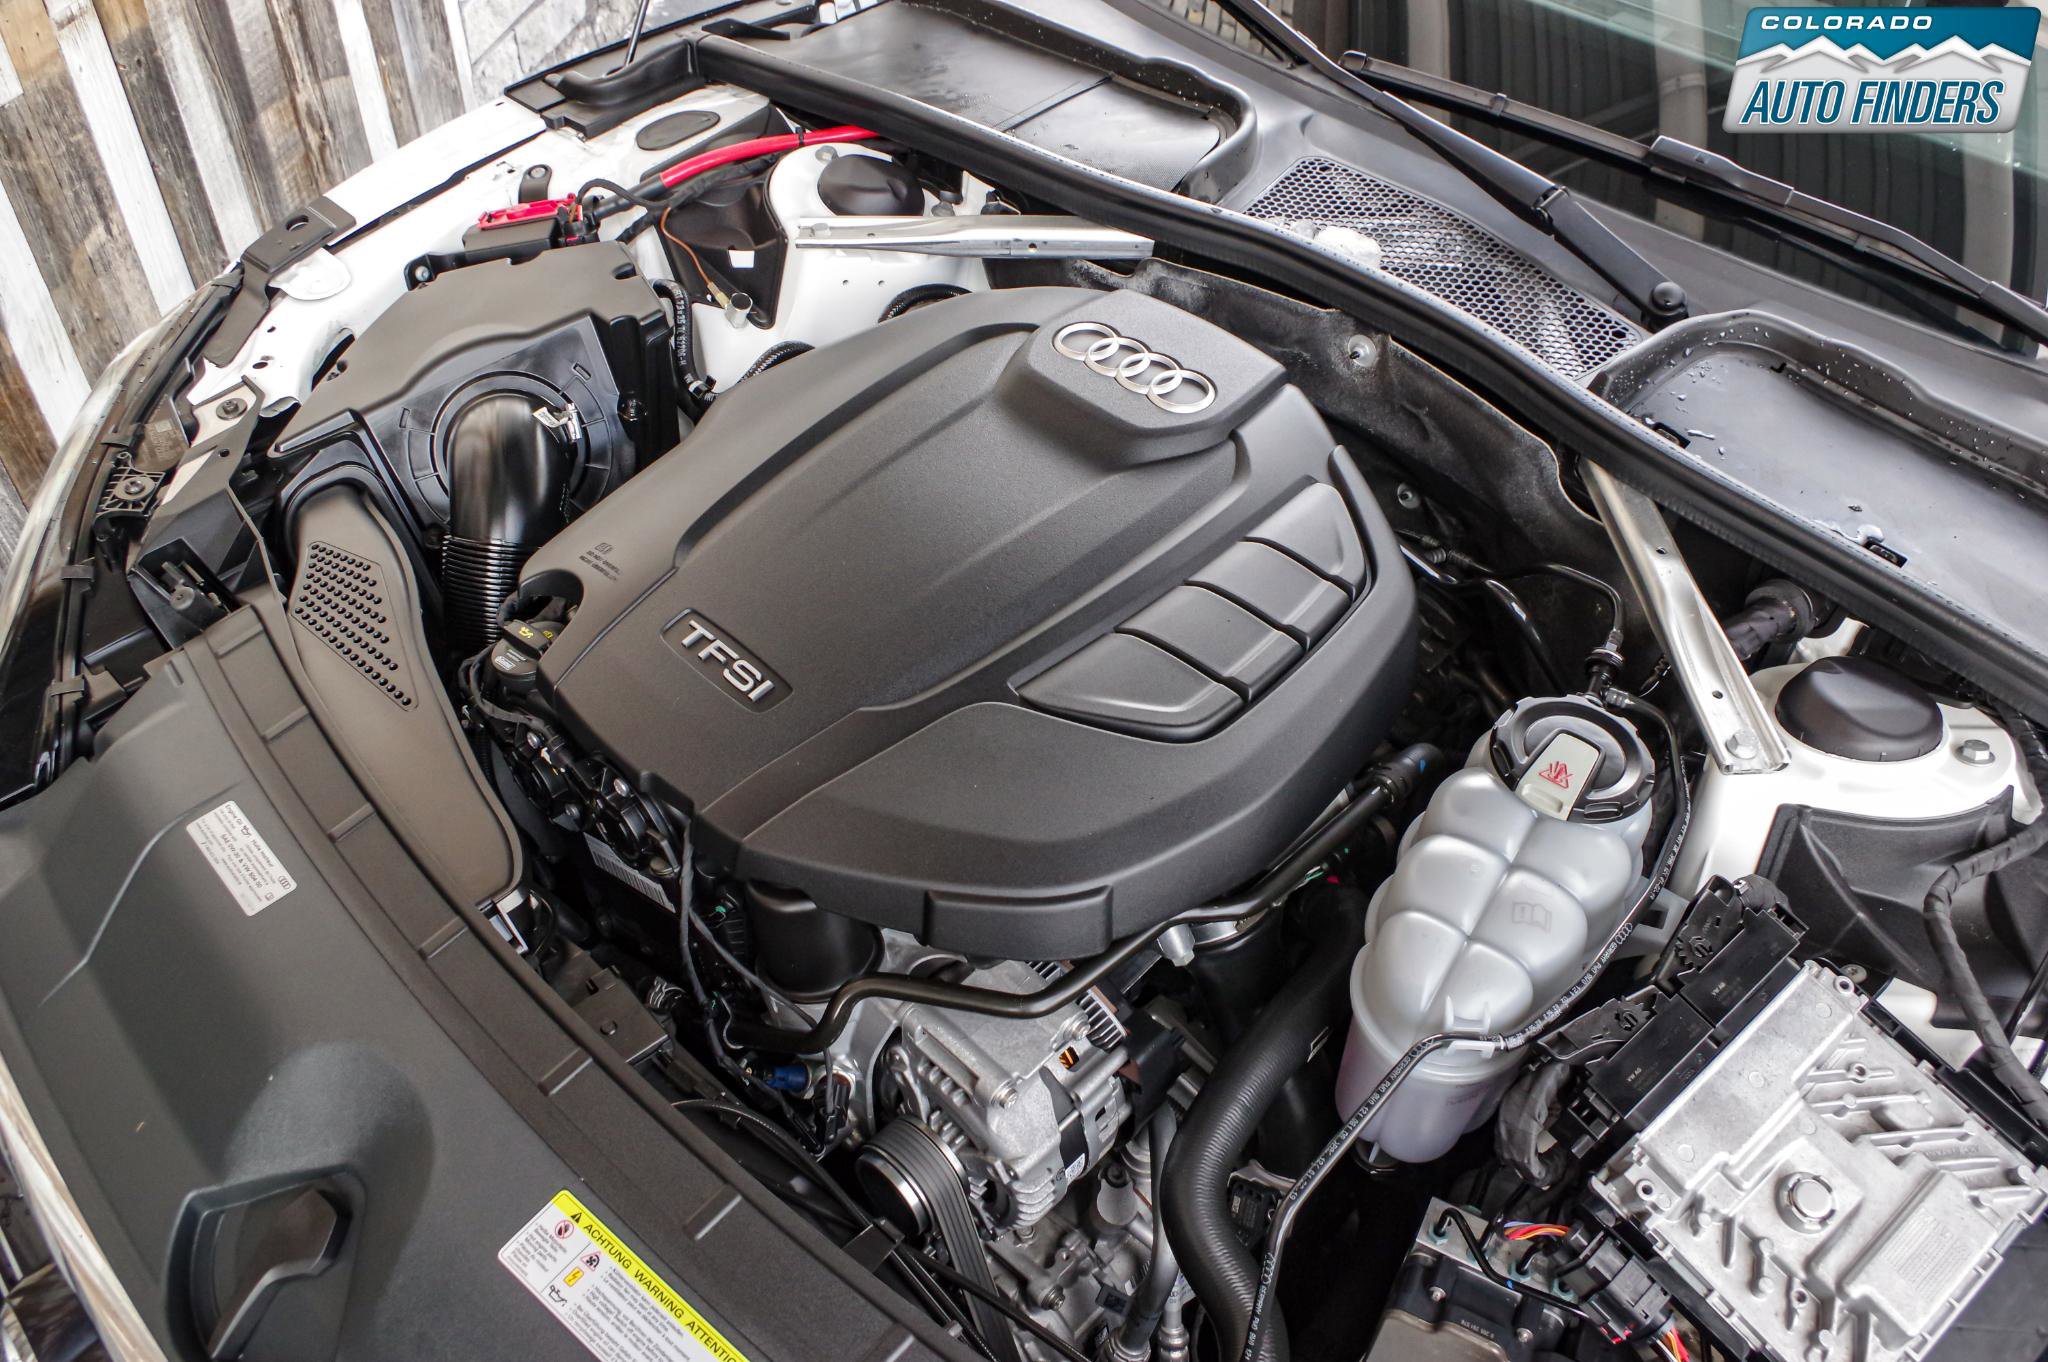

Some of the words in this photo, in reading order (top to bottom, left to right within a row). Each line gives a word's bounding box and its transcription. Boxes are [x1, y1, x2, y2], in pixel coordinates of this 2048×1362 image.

[681, 619, 776, 702] TFSI
[584, 1223, 632, 1269] ACHTUNG
[633, 1268, 684, 1319] WARNING
